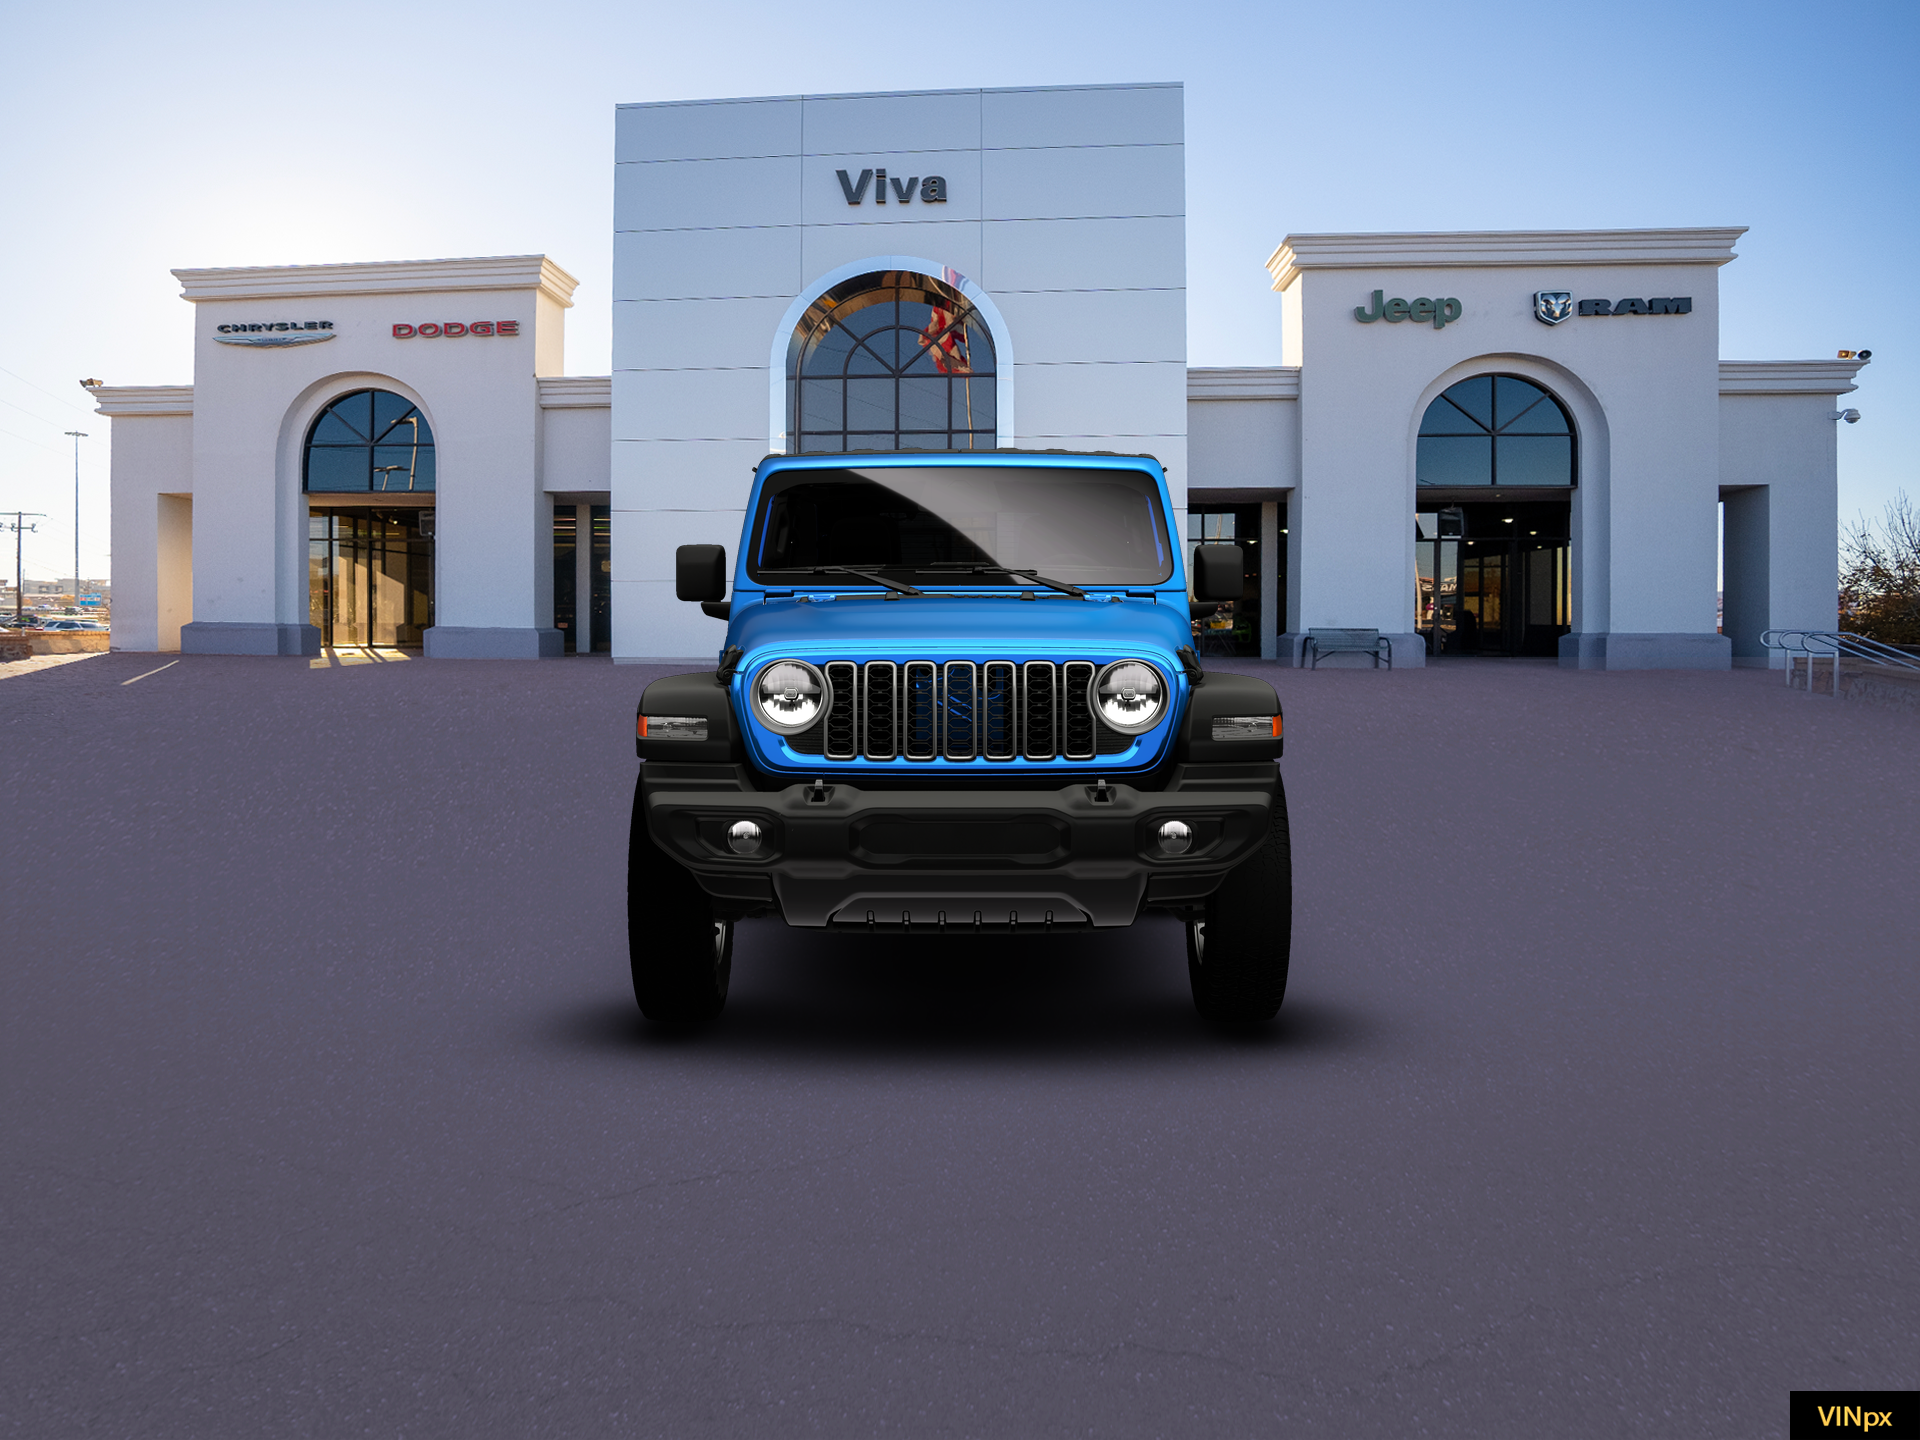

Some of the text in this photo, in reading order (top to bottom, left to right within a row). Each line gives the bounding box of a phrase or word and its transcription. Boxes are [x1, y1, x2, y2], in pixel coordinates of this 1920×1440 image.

[835, 168, 947, 205] Viva
[1354, 289, 1463, 329] Jeep
[1578, 296, 1693, 316] RAM
[216, 320, 334, 334] CHRYSLER
[392, 319, 520, 339] DODGE
